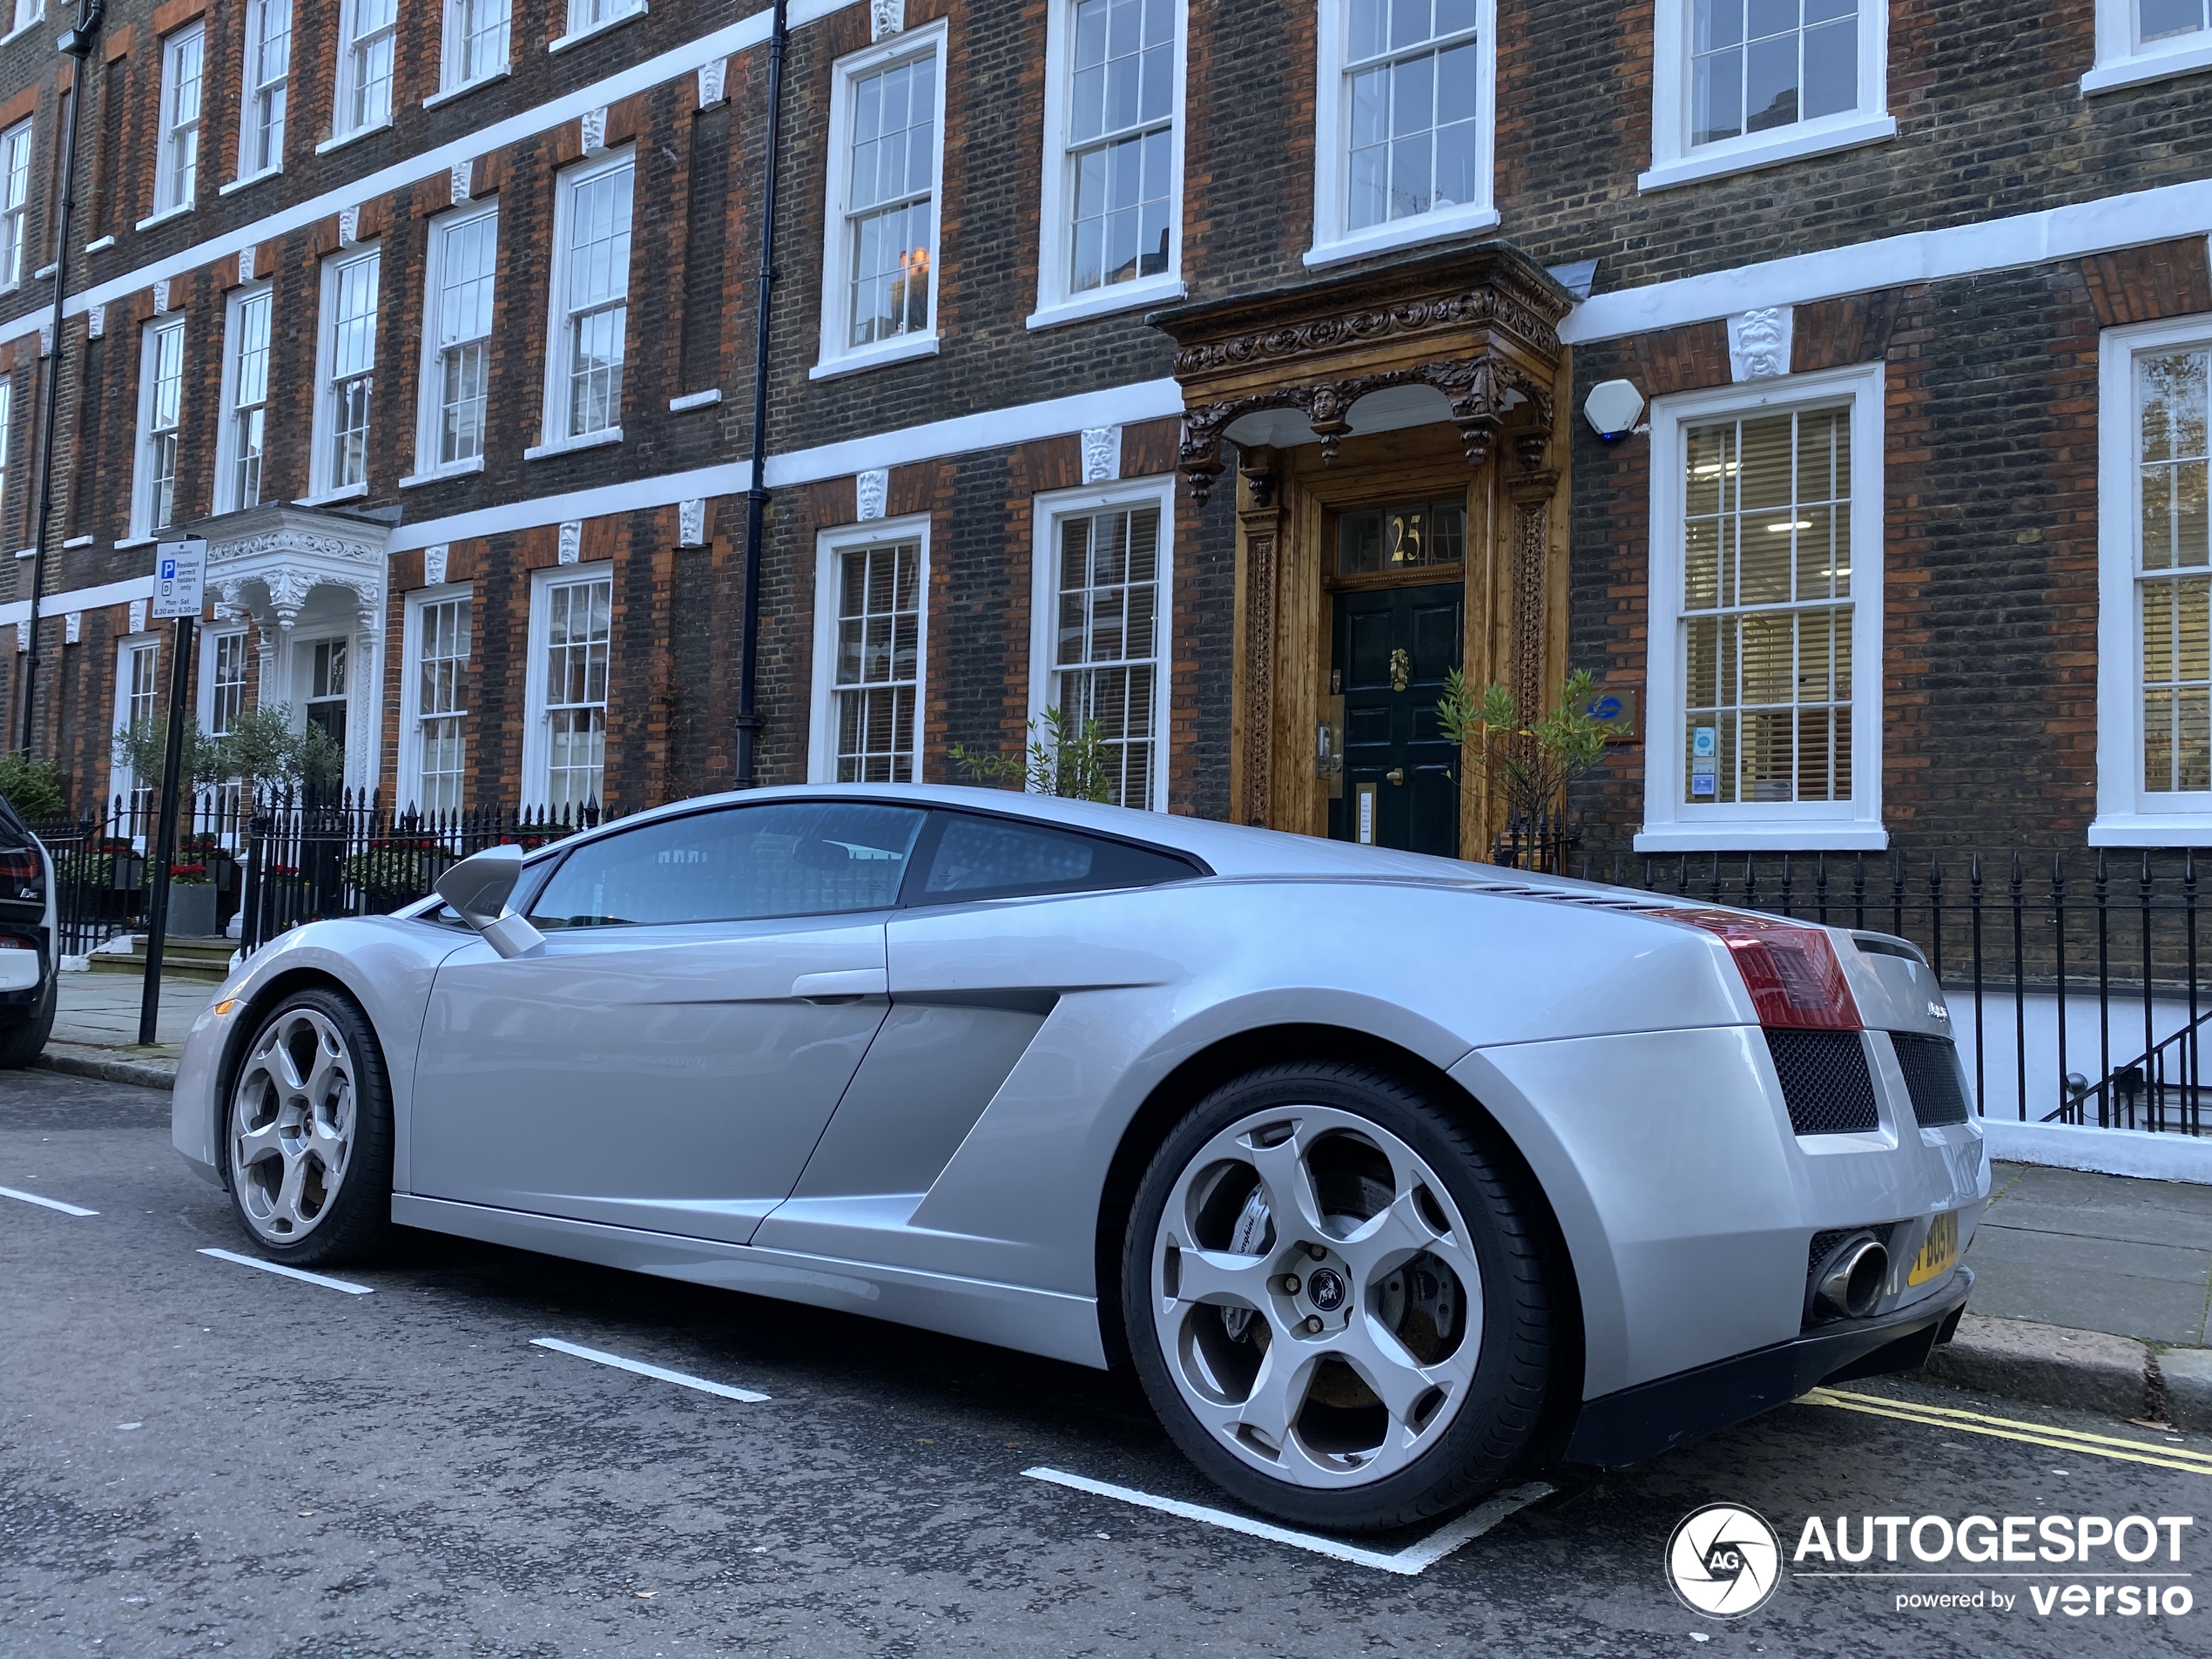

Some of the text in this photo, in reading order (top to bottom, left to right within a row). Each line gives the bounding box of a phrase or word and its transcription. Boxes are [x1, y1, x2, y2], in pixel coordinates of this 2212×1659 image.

[1391, 515, 1421, 562] 25
[164, 562, 173, 577] P
[334, 664, 344, 675] 23
